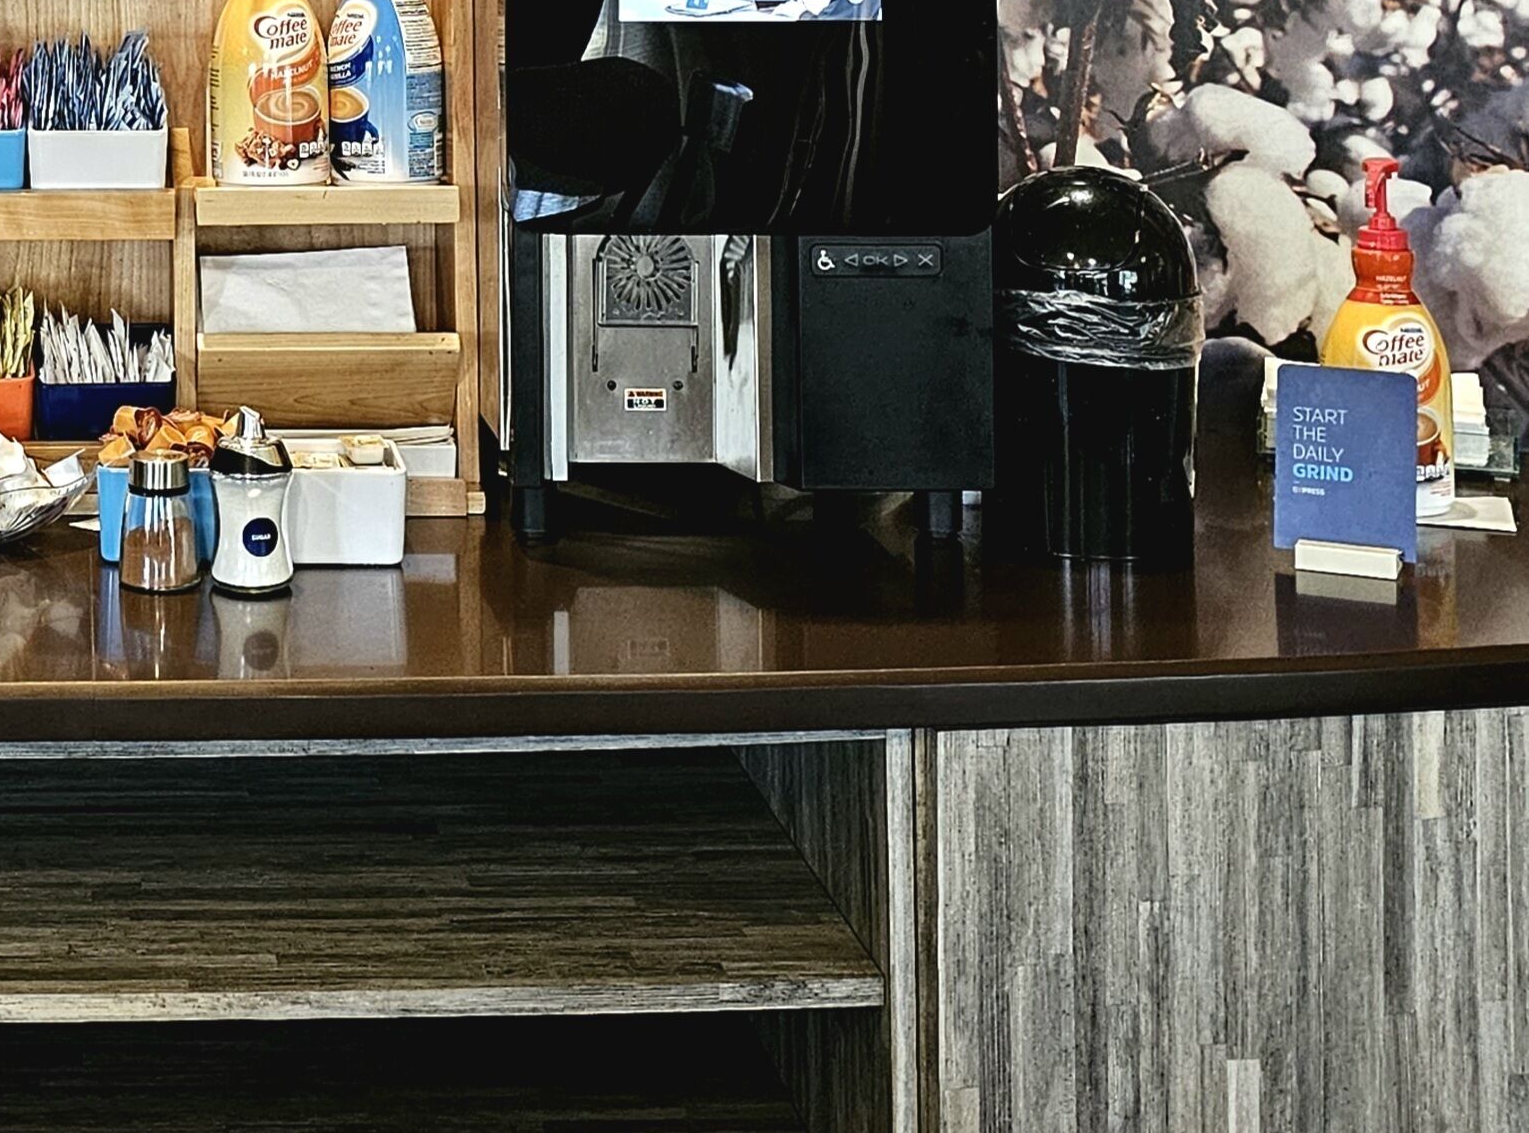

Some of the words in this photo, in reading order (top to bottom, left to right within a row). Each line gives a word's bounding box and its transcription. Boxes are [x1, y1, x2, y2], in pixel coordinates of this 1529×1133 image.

[254, 16, 308, 39] Coffee
[270, 32, 308, 49] mate
[863, 255, 889, 266] OK
[1363, 330, 1424, 355] Coffee
[1379, 349, 1423, 366] mate
[1293, 406, 1348, 425] START
[1293, 425, 1326, 443] THE
[1293, 443, 1344, 462] DAILY
[1293, 463, 1353, 482] GRIND
